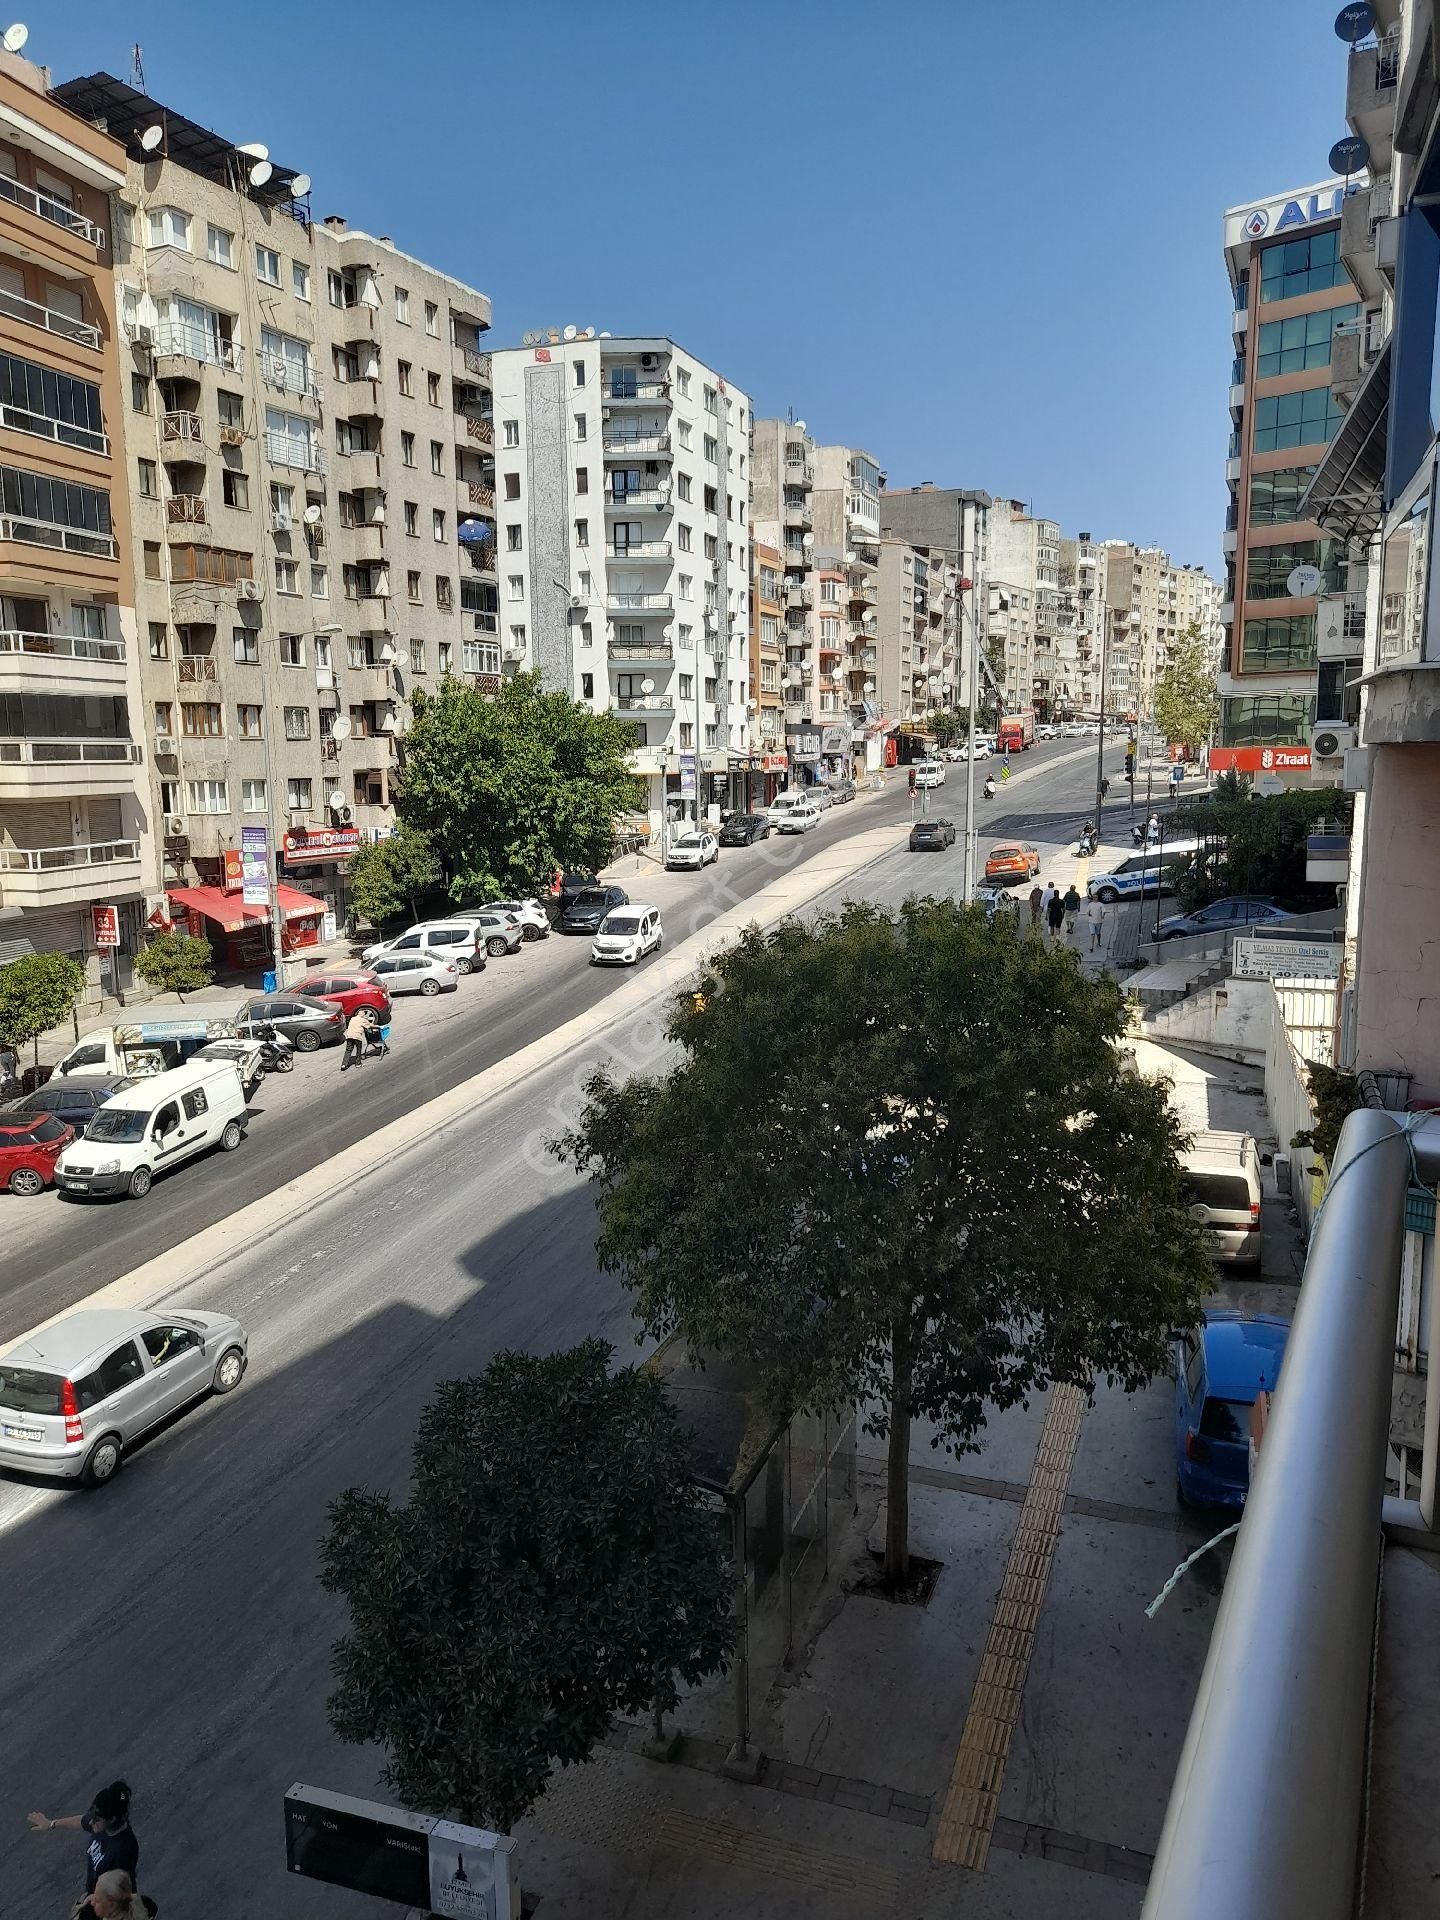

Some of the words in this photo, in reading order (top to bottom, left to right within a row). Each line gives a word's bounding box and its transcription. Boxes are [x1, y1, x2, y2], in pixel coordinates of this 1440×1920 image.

[1275, 753, 1308, 766] Ziraat
[1298, 946, 1311, 955] Özel
[1312, 947, 1329, 956] Servis
[292, 1812, 308, 1823] HAT
